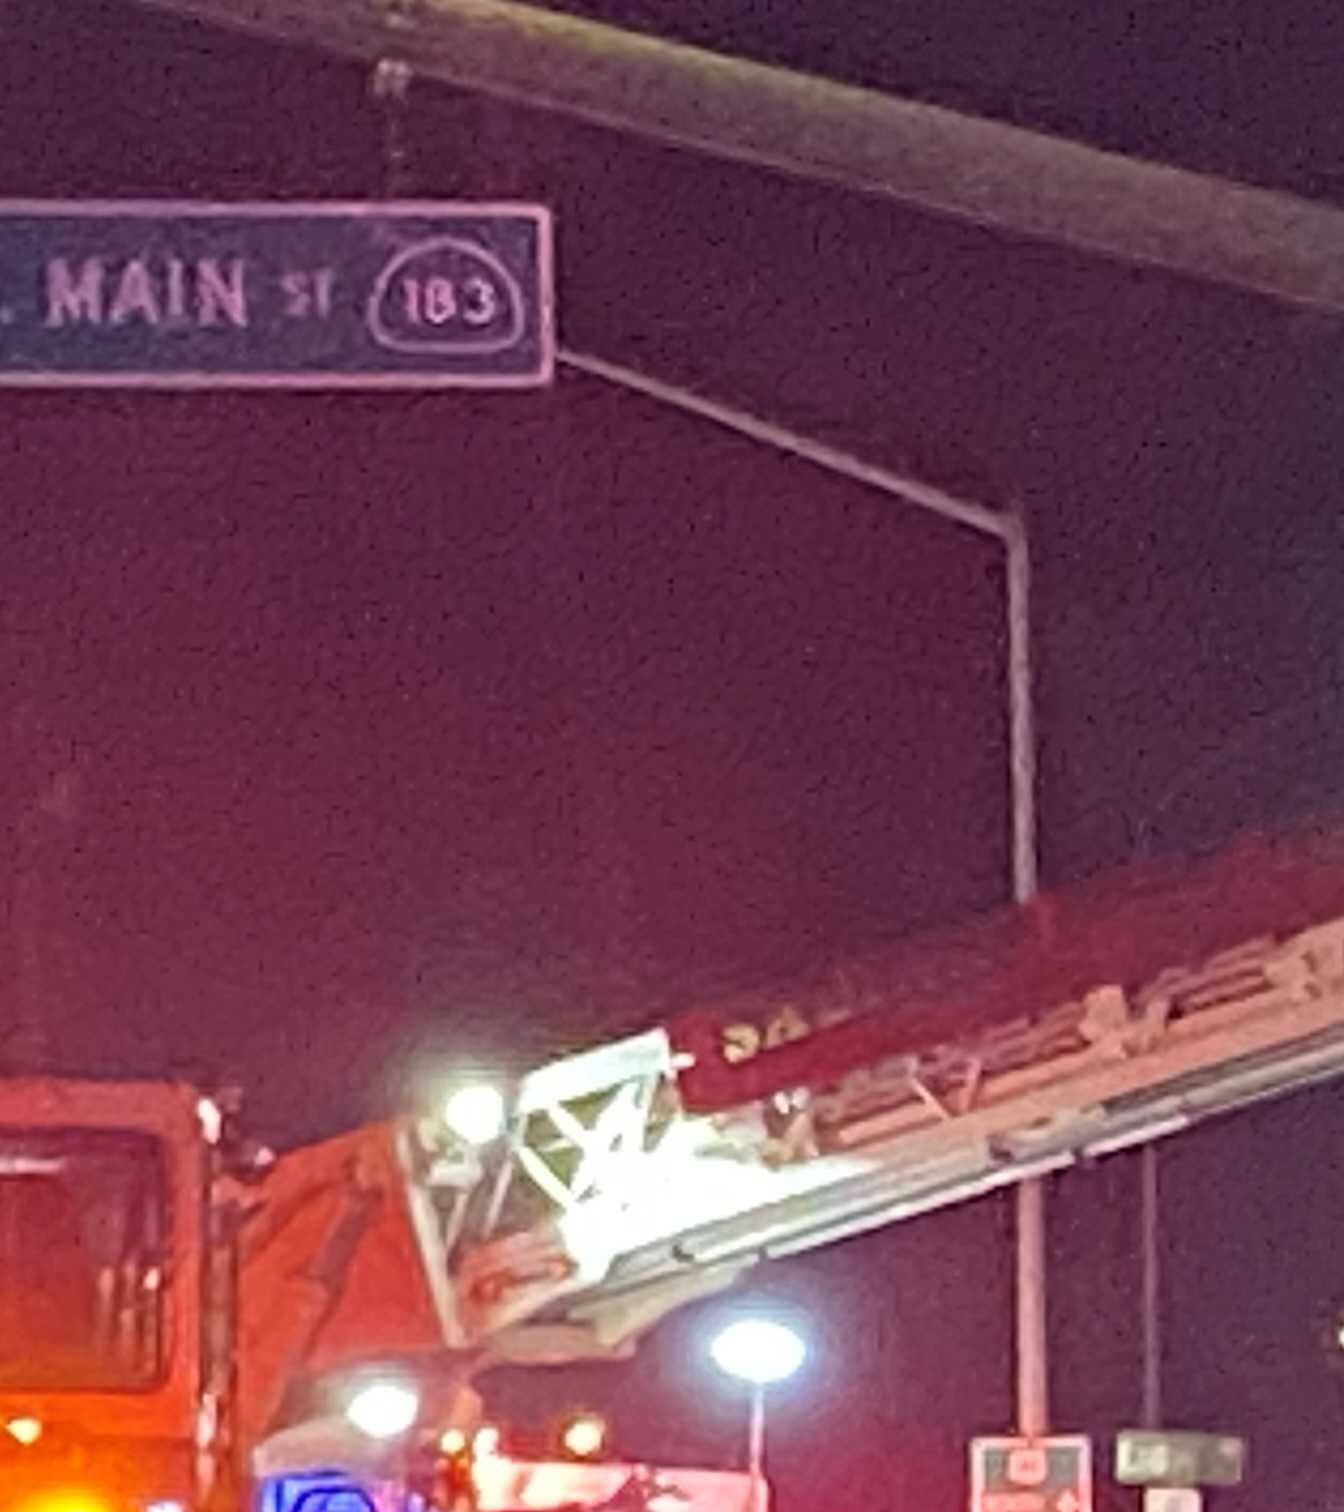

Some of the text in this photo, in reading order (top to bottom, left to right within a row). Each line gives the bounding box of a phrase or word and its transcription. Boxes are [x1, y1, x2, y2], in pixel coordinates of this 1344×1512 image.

[44, 257, 335, 327] MAIN ST
[403, 275, 496, 325] 183
